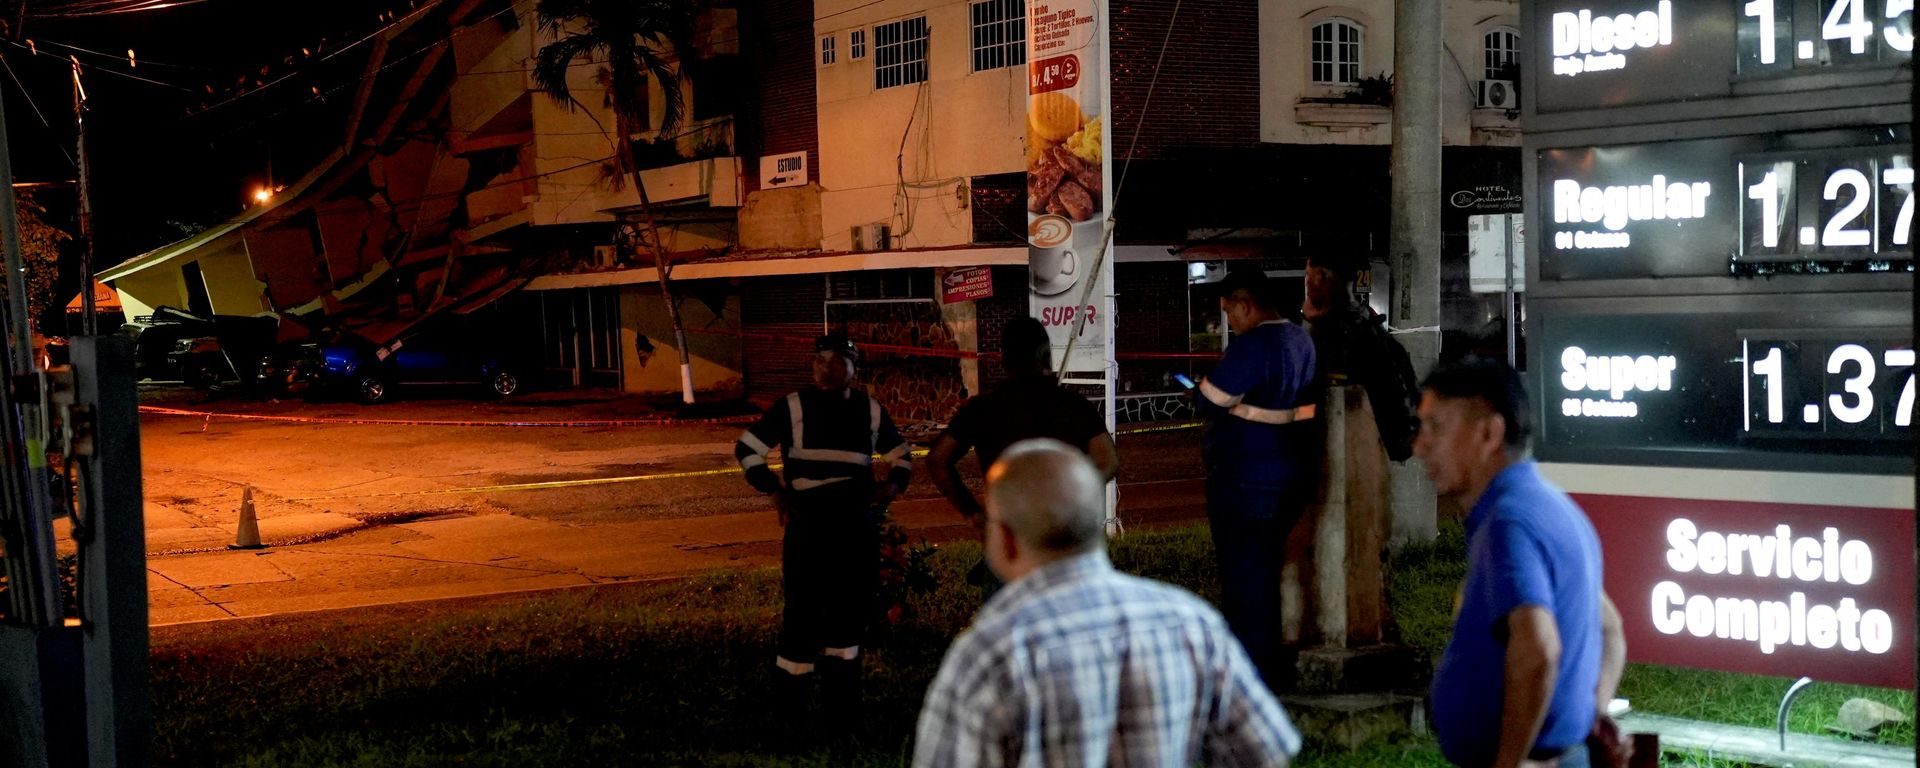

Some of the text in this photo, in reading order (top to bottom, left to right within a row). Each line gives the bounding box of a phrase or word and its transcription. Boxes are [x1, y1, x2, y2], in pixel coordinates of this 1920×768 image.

[1552, 0, 1672, 56] Diesel
[778, 155, 802, 173] ESTUDIO
[1554, 174, 1711, 231] Regular
[1749, 168, 1915, 247] 1.27
[947, 282, 988, 294] IMPRESIONES
[965, 275, 987, 284] COPIAS
[965, 289, 988, 298] PLANOS
[1561, 346, 1676, 400] Super
[1753, 344, 1915, 426] 1.37
[1666, 518, 1873, 585] Servicio
[1651, 581, 1893, 654] Completo
